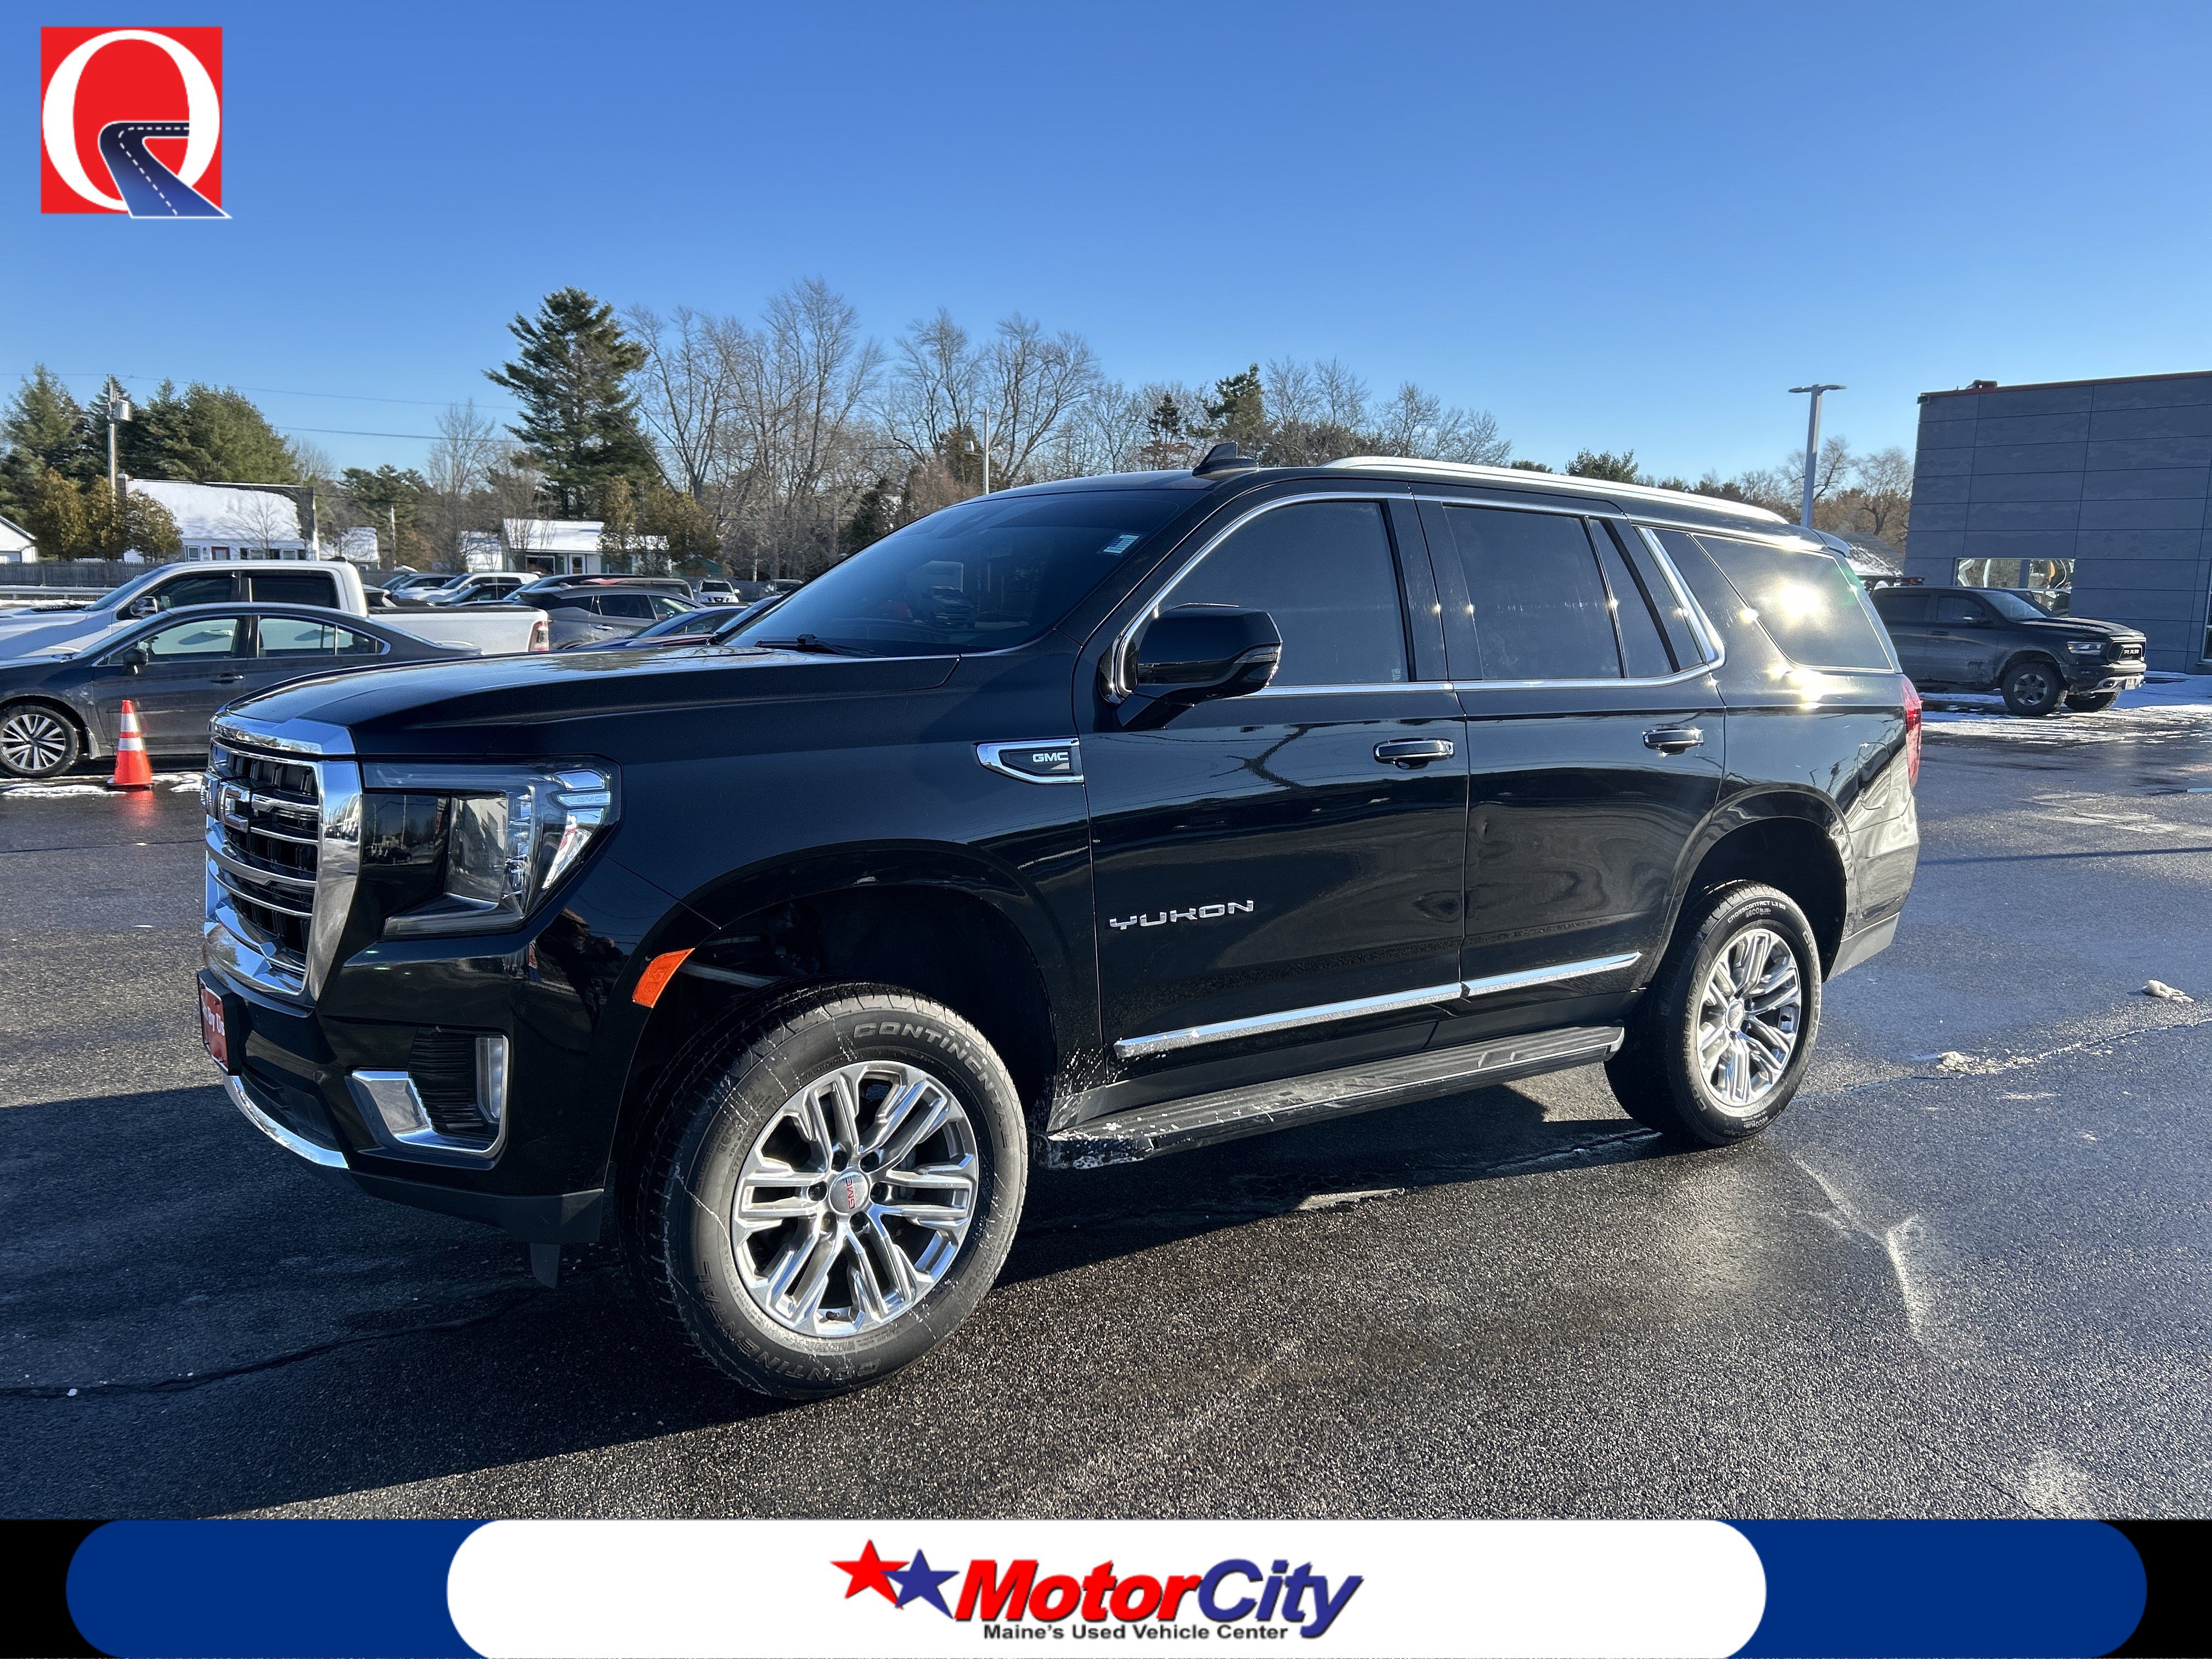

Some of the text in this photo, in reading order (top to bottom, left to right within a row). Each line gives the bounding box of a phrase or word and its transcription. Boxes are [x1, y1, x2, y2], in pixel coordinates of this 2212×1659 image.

[1032, 752, 1069, 763] GMC
[1109, 900, 1254, 930] YUKON
[1727, 900, 1770, 923] CROSSCONTACT
[1683, 961, 1709, 1113] CONTINENTAL
[854, 1022, 1008, 1148] CONTINENTAL
[845, 1176, 856, 1210] GMC
